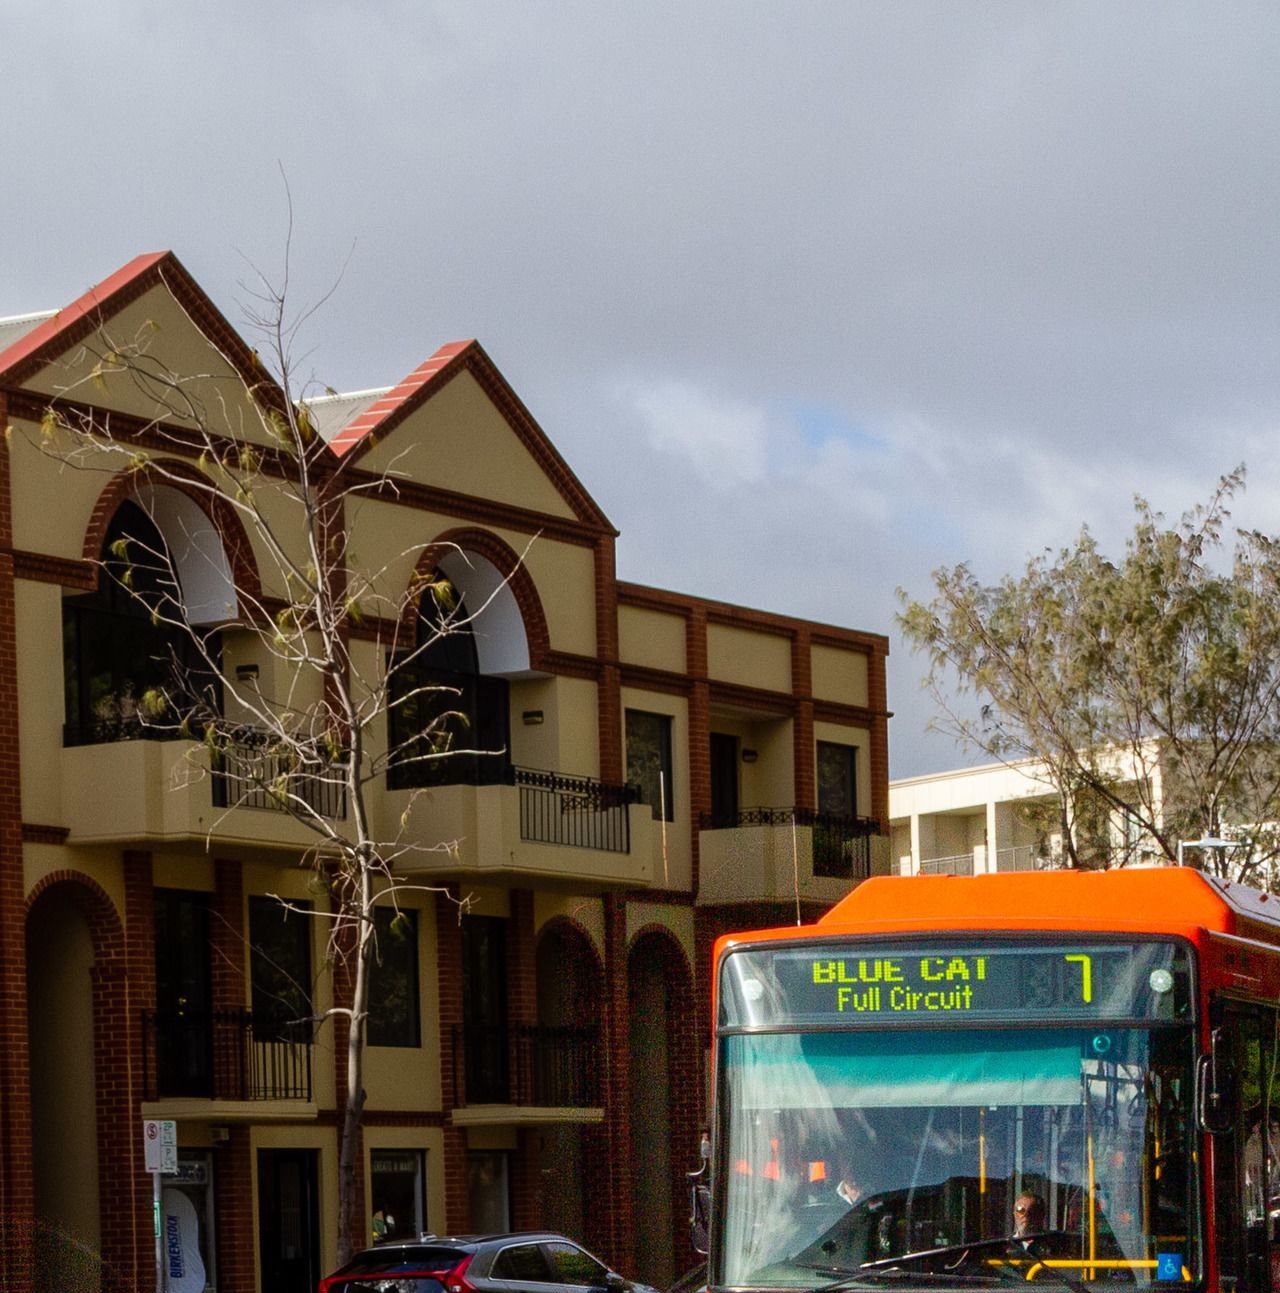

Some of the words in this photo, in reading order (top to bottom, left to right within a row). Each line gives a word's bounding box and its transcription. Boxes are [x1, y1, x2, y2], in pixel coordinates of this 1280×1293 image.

[812, 958, 904, 983] BLUE
[920, 956, 990, 981] CAT
[837, 986, 880, 1011] Full
[890, 984, 973, 1010] Circuit
[167, 1215, 182, 1279] BIRKENSTOCK
